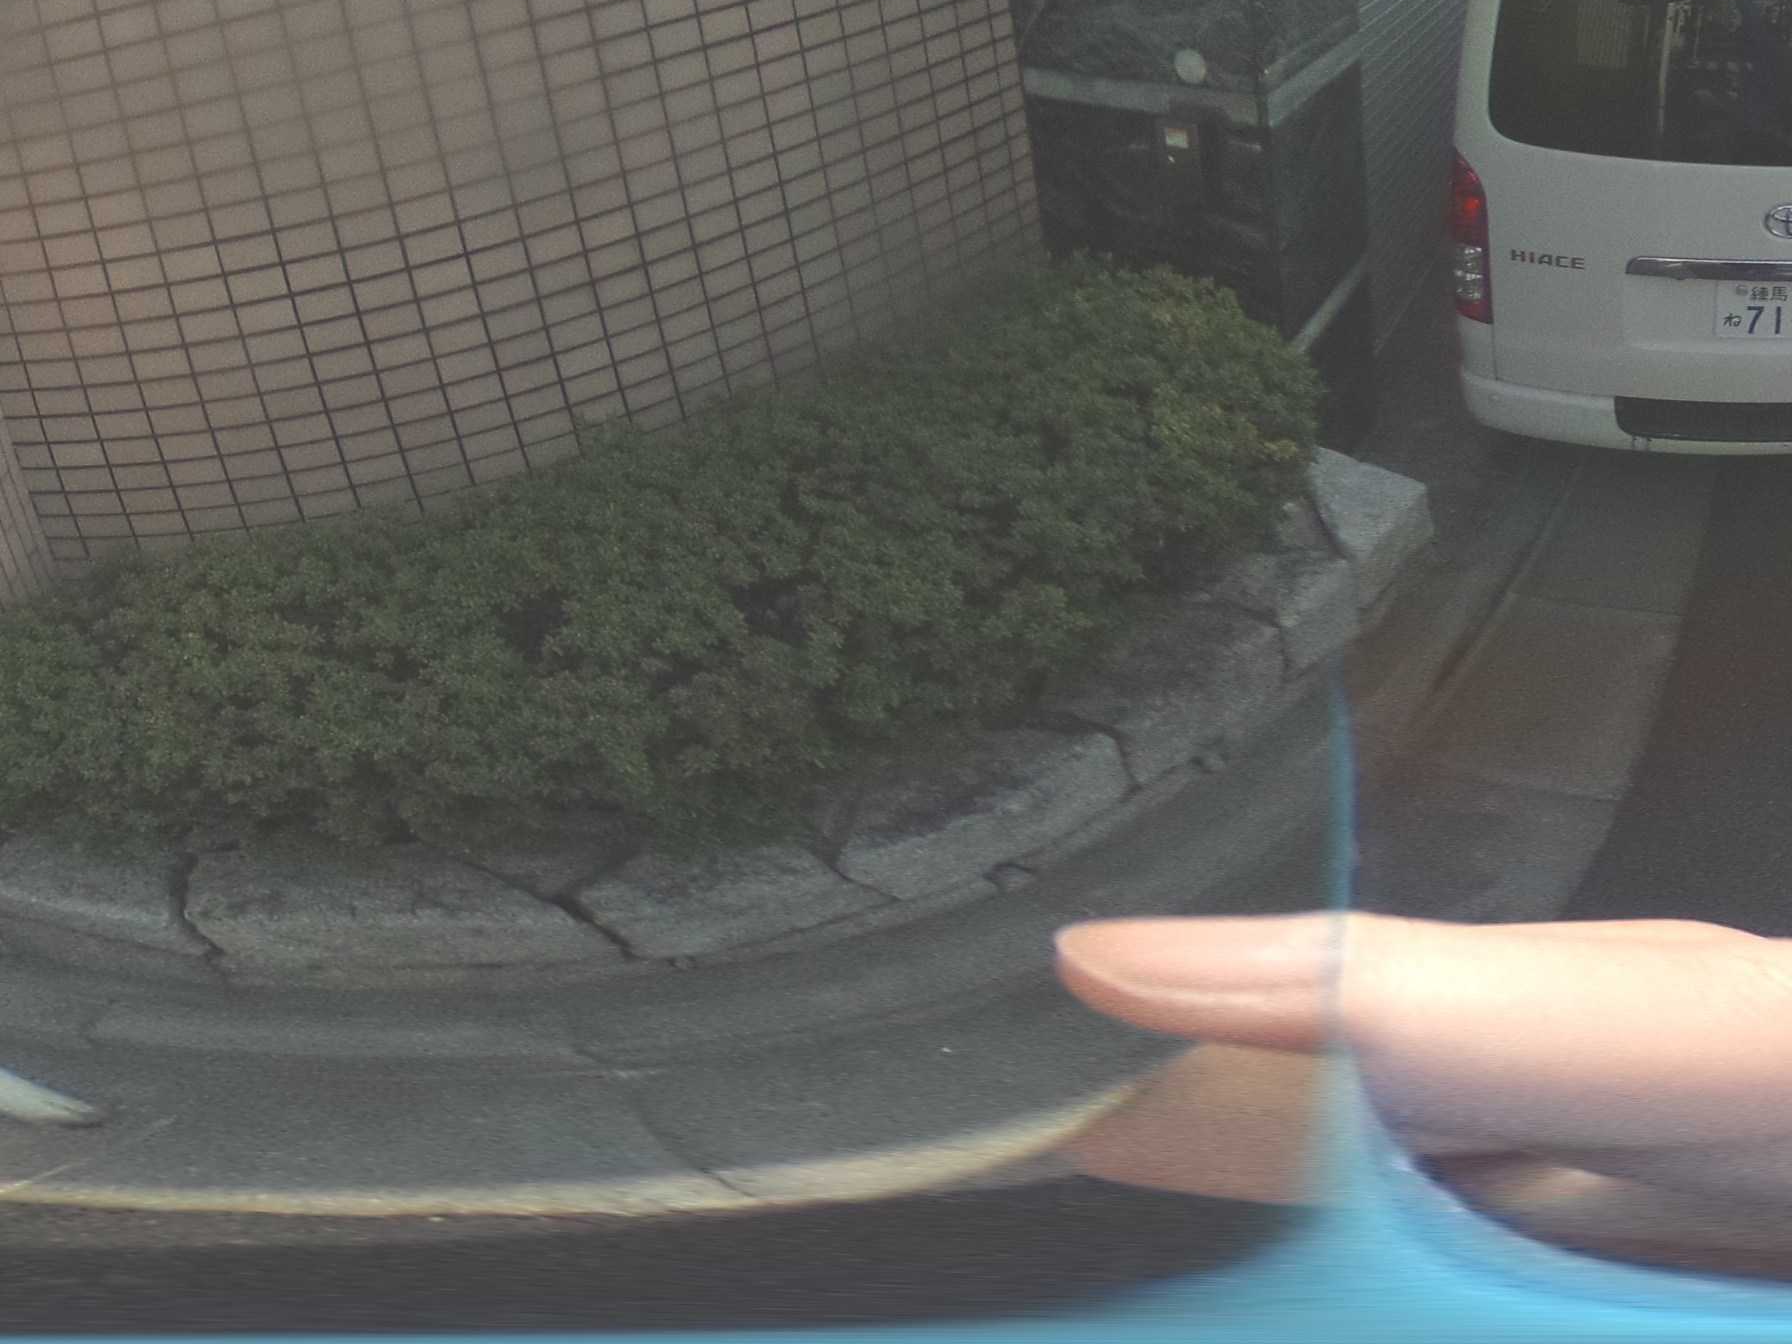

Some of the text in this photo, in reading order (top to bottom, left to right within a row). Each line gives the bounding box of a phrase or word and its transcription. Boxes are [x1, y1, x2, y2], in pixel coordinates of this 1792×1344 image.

[1510, 249, 1585, 270] HIACE
[1749, 286, 1788, 301] 練馬
[1723, 313, 1742, 327] ね
